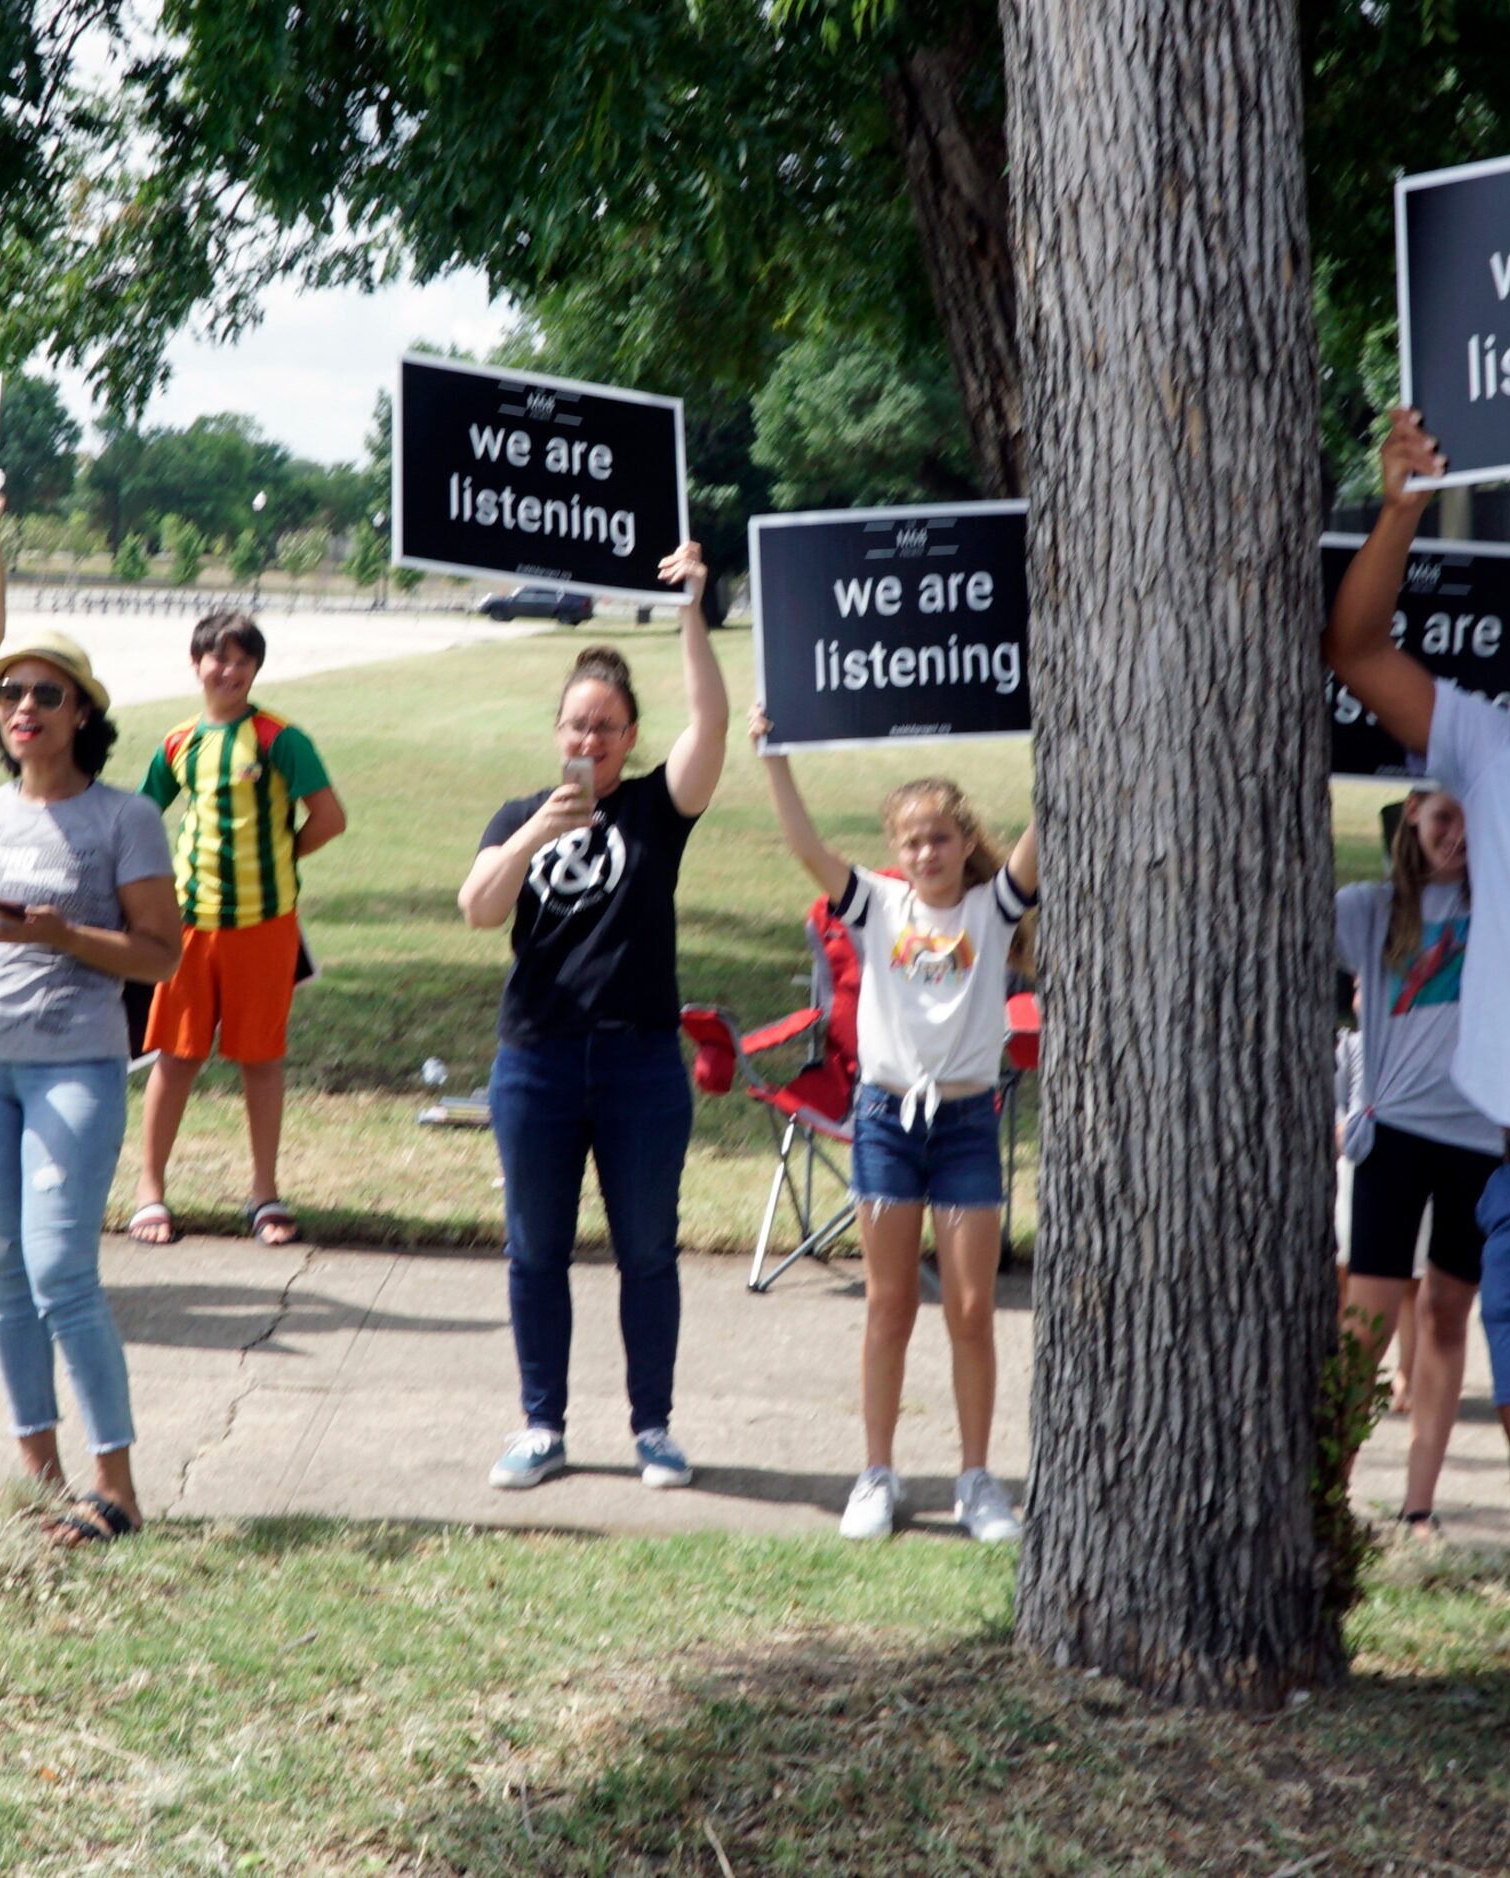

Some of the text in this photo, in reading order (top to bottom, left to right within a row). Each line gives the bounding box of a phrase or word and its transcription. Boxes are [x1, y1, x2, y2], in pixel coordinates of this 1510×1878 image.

[469, 423, 613, 480] we are
[450, 472, 636, 557] listening
[834, 571, 994, 618] we are
[1422, 612, 1503, 658] are
[815, 633, 1021, 695] listening
